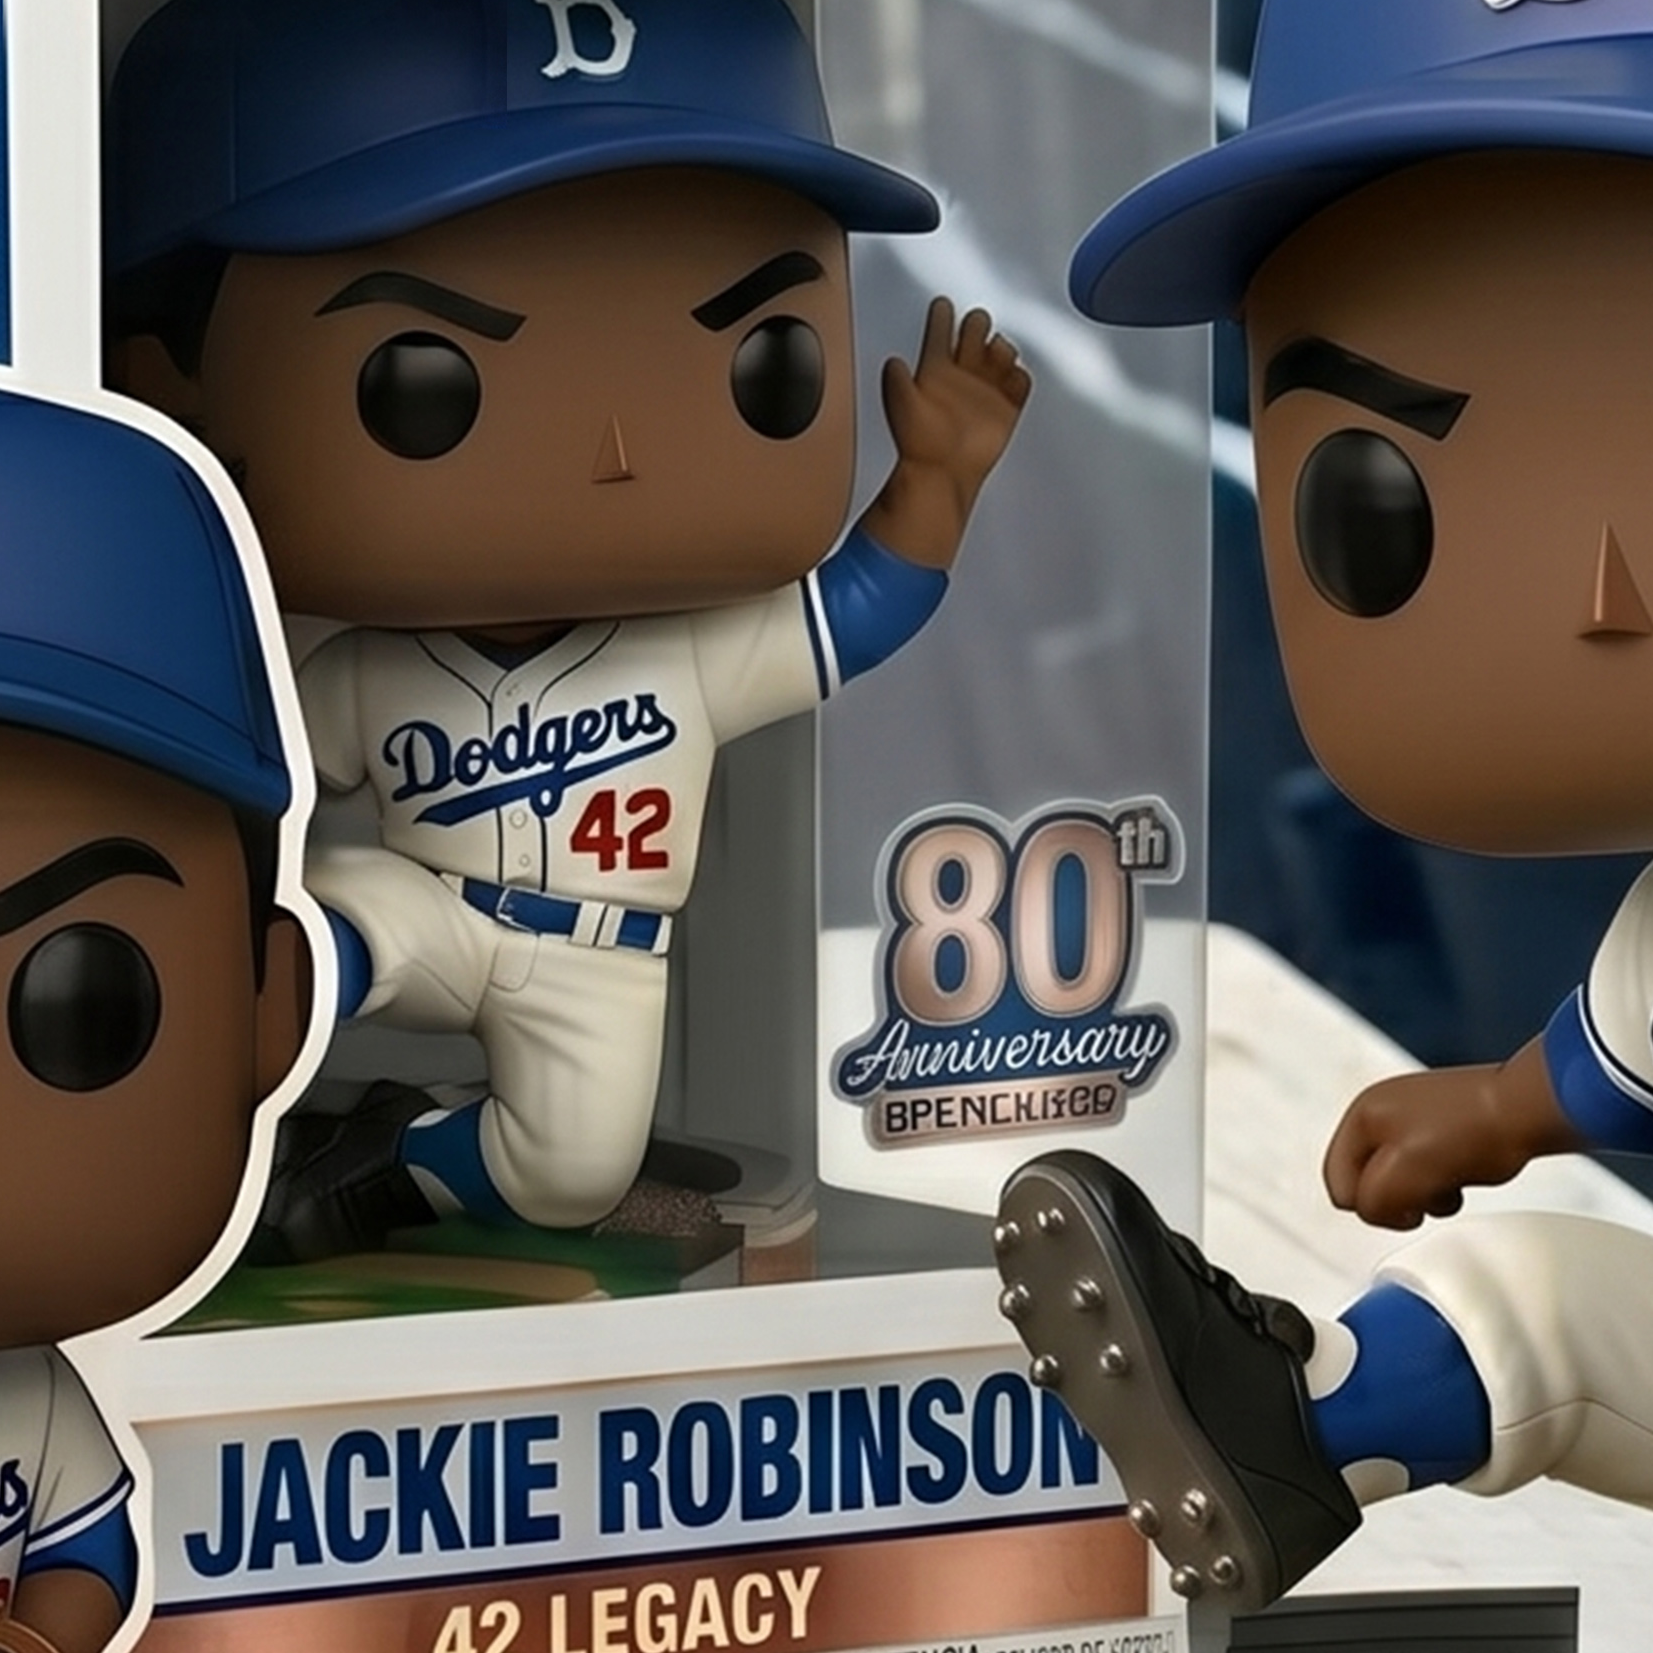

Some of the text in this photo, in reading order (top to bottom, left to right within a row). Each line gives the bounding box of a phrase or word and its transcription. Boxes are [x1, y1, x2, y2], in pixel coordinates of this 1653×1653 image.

[383, 693, 678, 827] Dodgers
[569, 788, 672, 873] 42
[184, 1370, 1100, 1579] JACKIE ROBINSON
